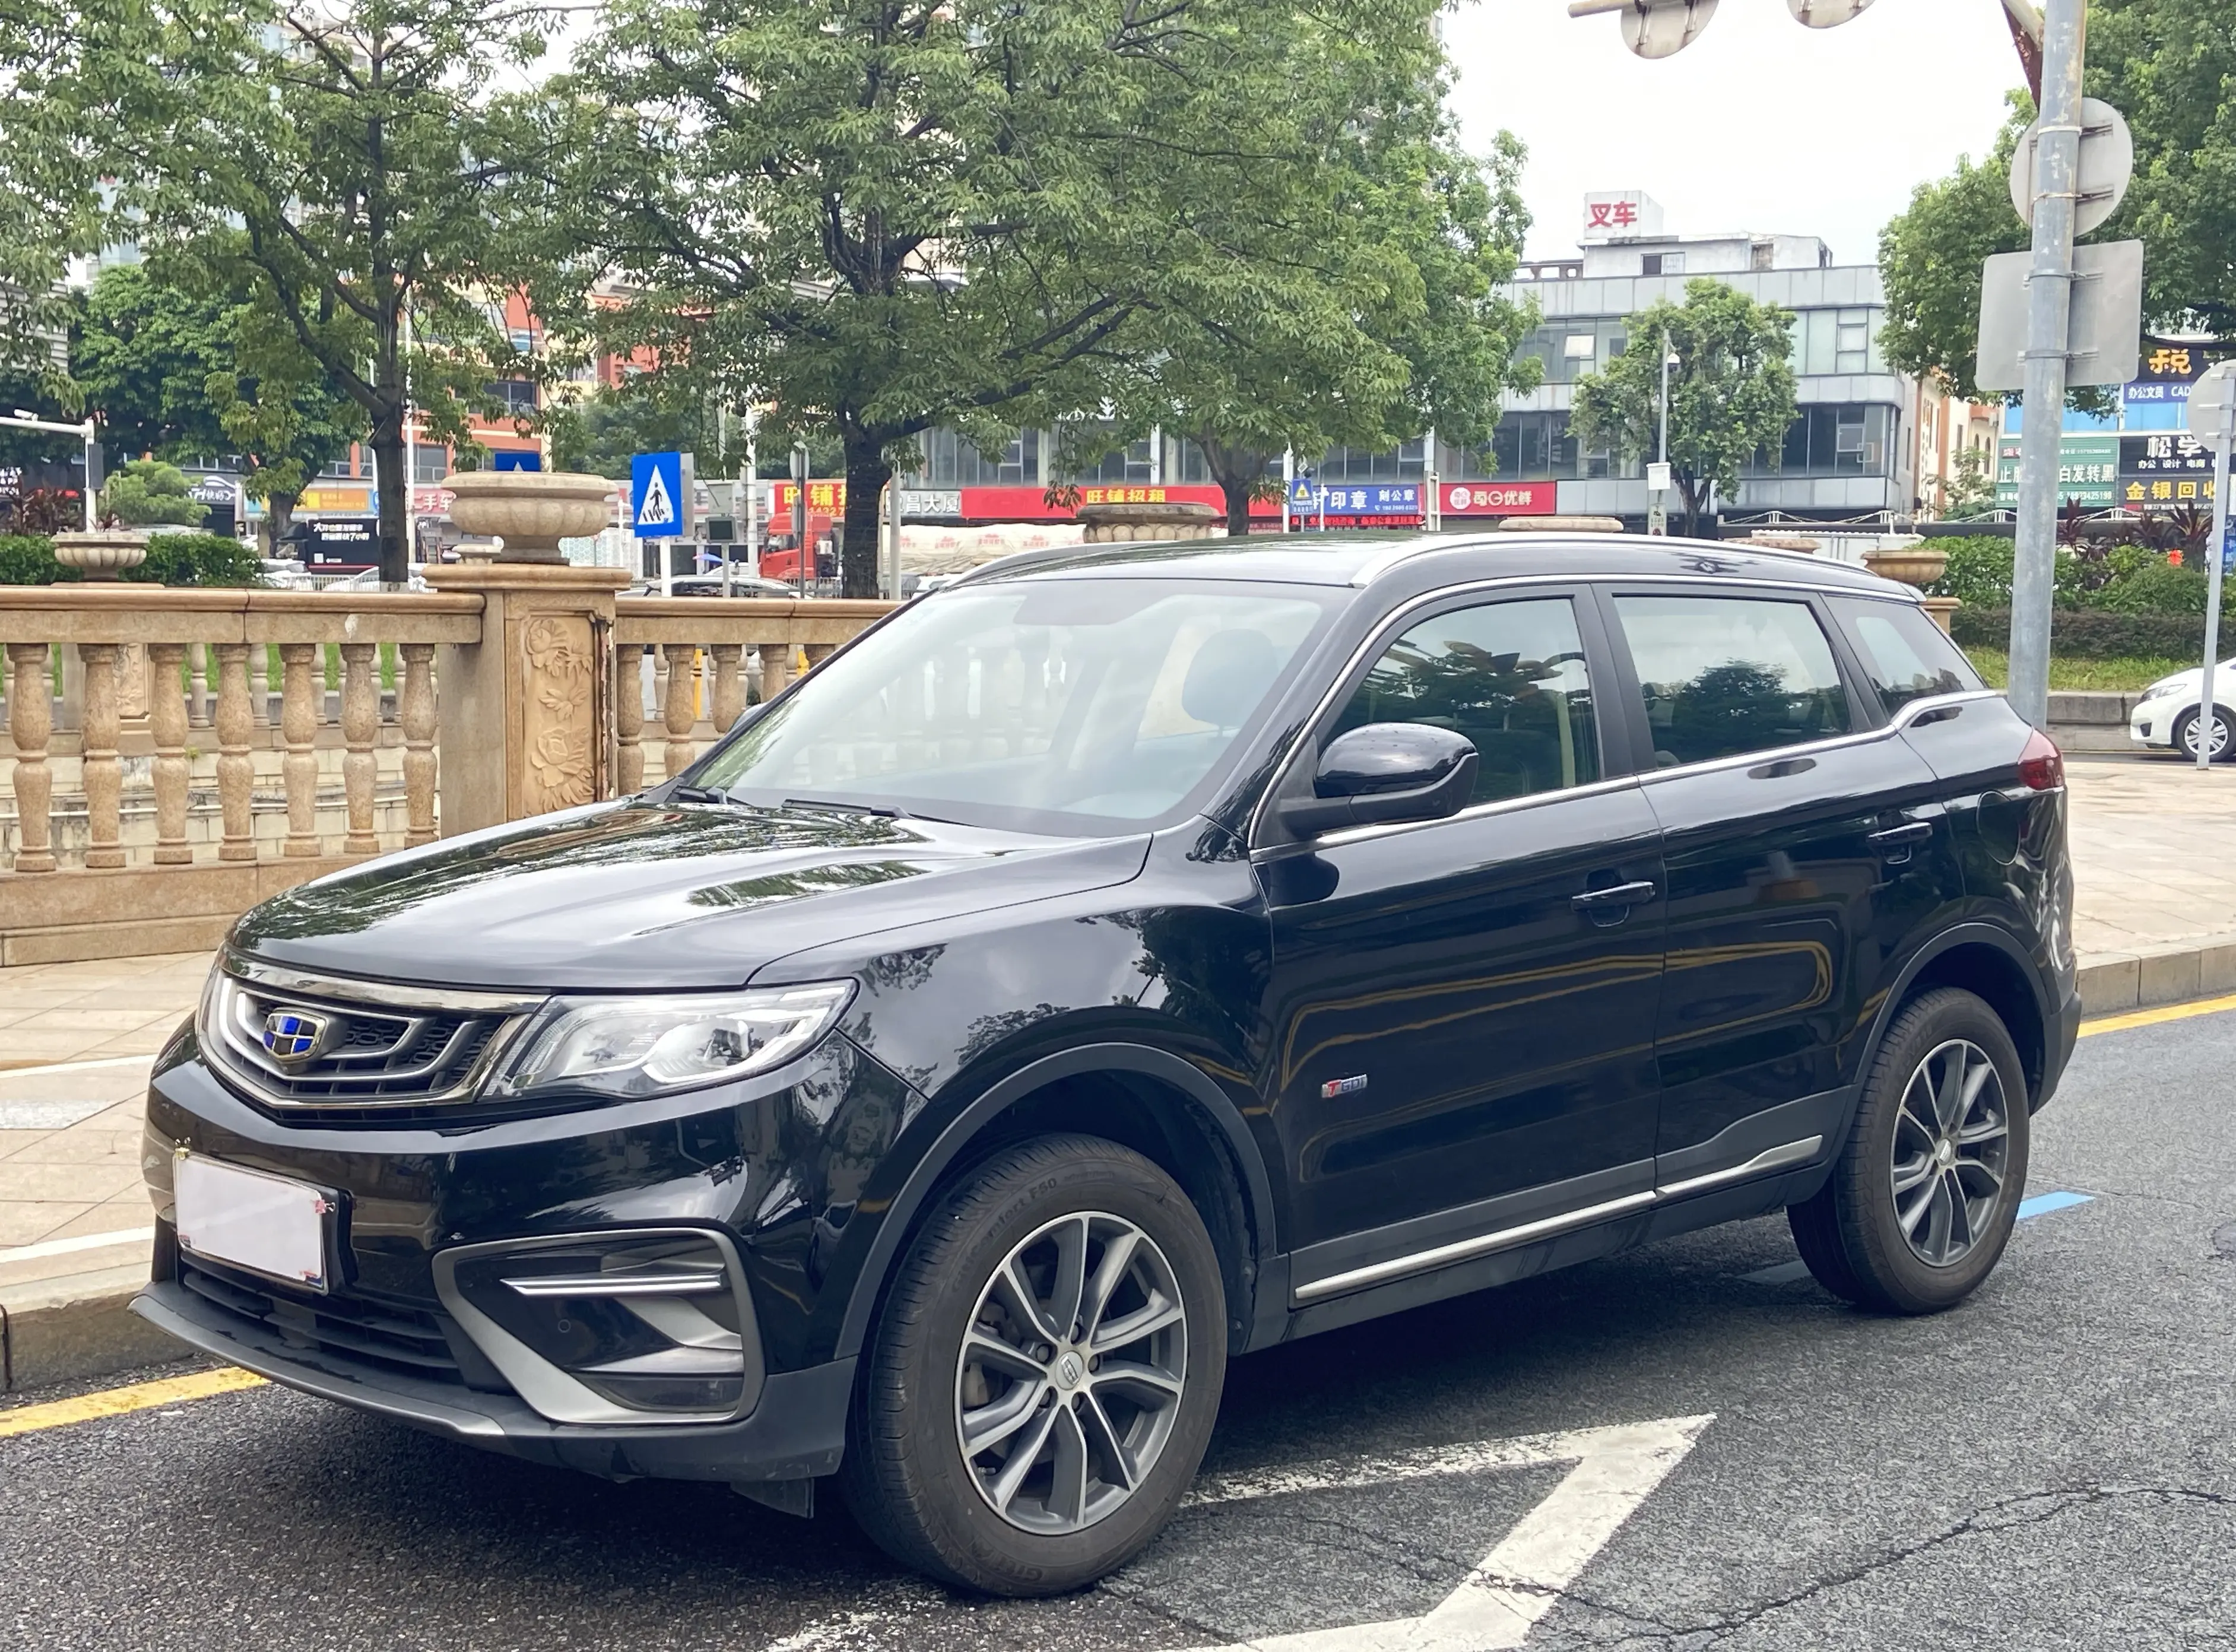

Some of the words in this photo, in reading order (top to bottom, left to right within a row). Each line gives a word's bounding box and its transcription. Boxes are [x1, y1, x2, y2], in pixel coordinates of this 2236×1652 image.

[1587, 201, 1638, 228] 叉车
[2128, 386, 2164, 399] 办公文员
[2137, 459, 2156, 469] 办公
[2162, 459, 2182, 469] 设计
[2059, 464, 2114, 483] 白发转黑
[886, 493, 960, 513] 昌大厦
[1378, 489, 1415, 502] 刻公章
